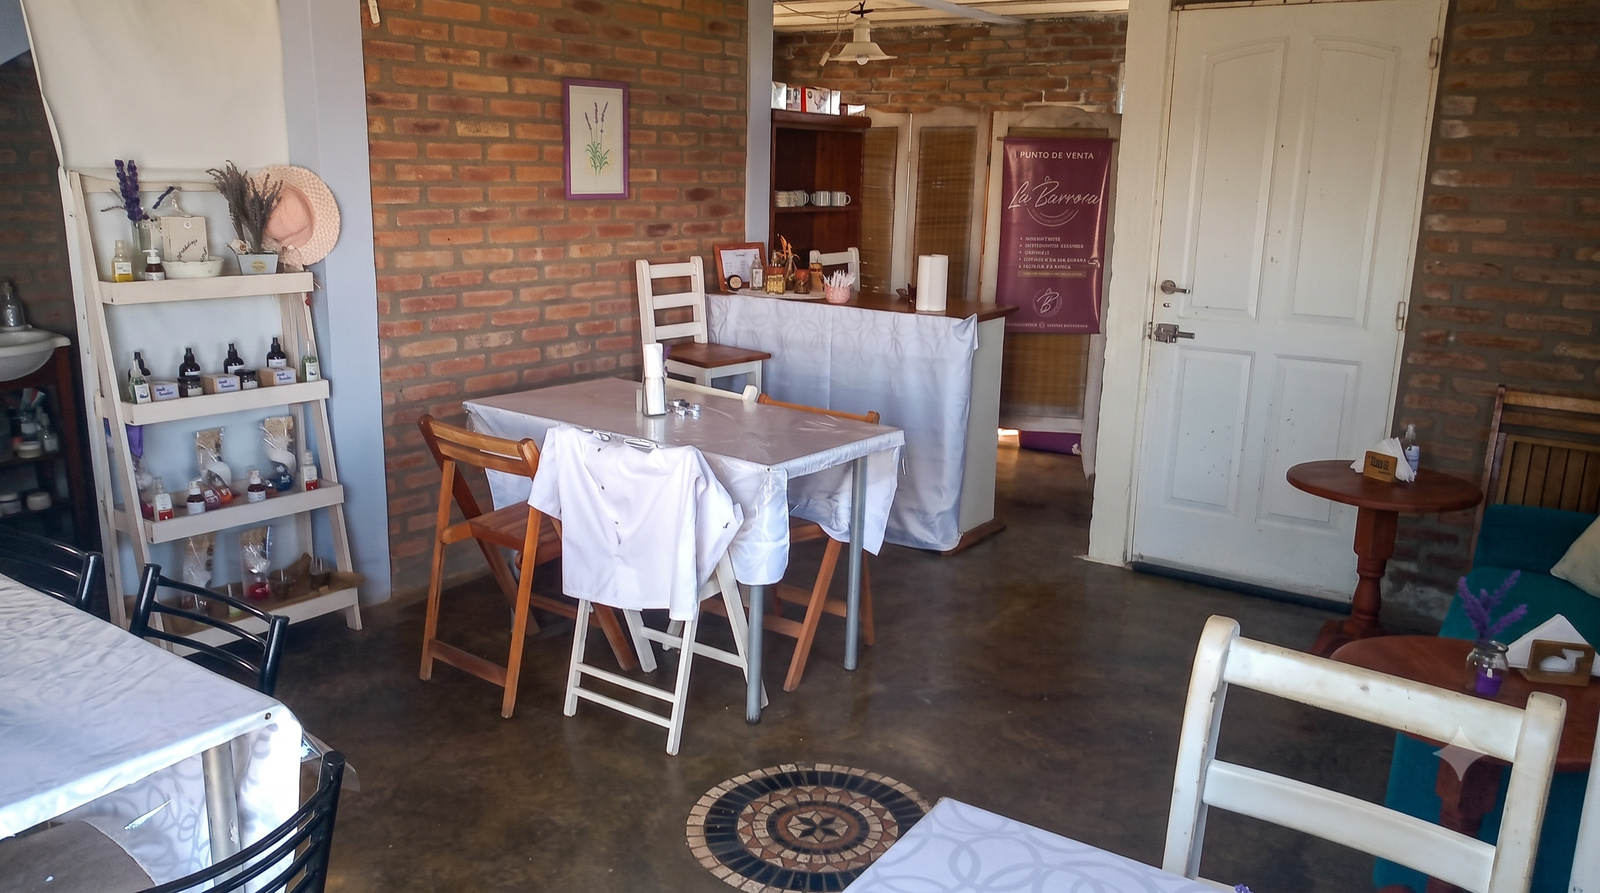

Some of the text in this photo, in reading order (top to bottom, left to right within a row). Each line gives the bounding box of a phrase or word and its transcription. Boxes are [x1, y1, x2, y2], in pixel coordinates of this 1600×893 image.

[1020, 151, 1095, 161] PUNTO DE VENTA
[1008, 181, 1031, 209] La
